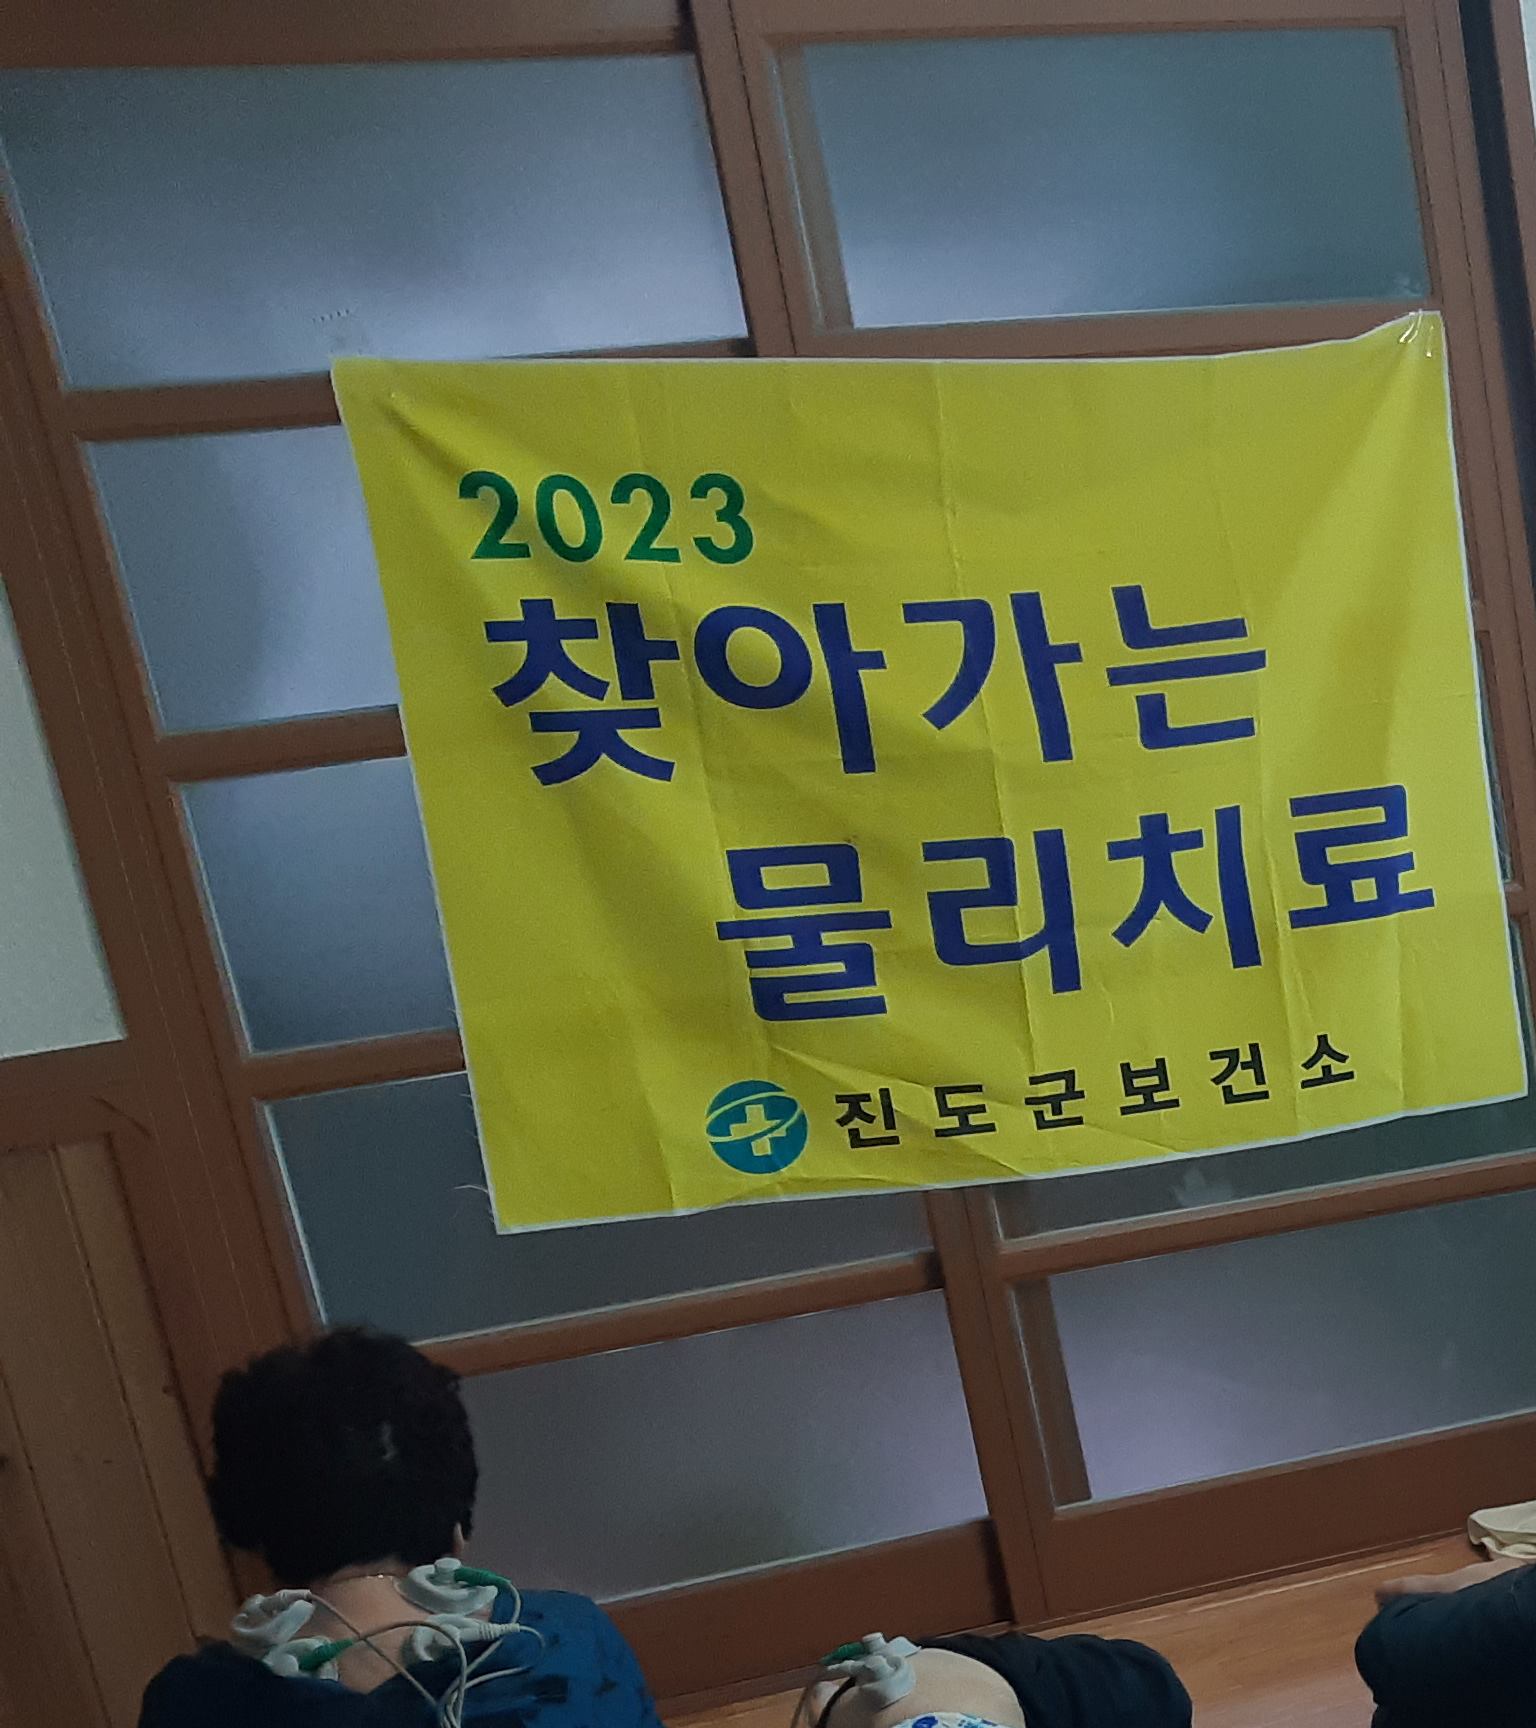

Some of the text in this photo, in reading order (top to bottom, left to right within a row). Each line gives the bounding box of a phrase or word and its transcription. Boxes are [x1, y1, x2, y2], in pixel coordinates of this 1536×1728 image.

[457, 470, 755, 565] 2023
[483, 585, 1269, 788] 찾아가는
[715, 784, 1436, 1023] 물리치료
[833, 1032, 1359, 1151] 진도군보건소
